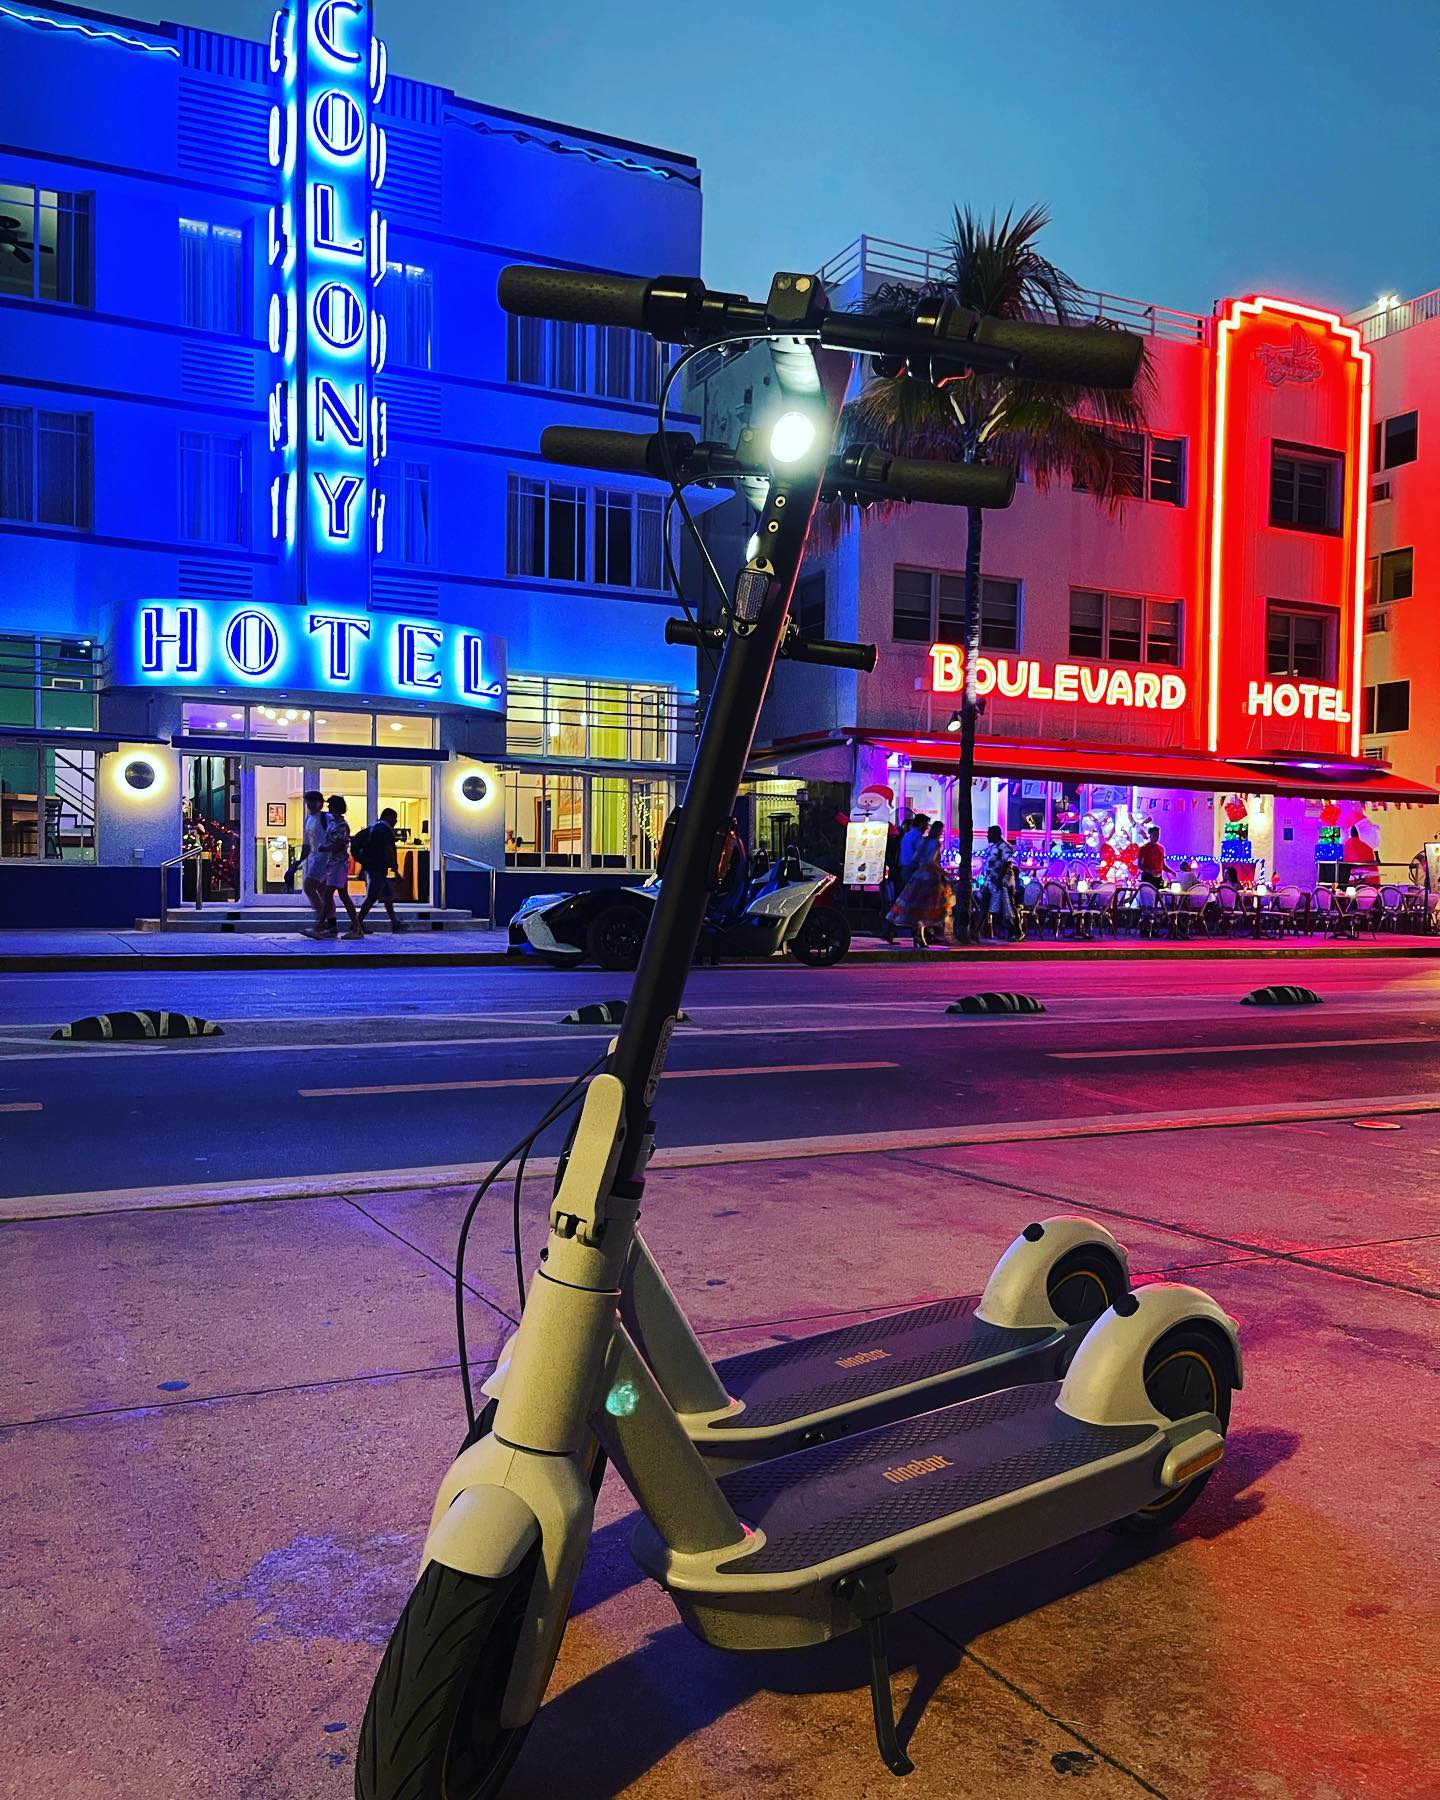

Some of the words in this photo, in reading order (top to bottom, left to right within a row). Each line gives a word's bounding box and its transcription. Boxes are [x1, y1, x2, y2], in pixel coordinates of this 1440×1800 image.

[314, 0, 364, 538] COLONY
[141, 607, 501, 696] HOTEL
[929, 643, 1186, 710] BOULEVARD
[1248, 681, 1351, 723] HOTEL
[882, 1454, 954, 1484] ninebot
